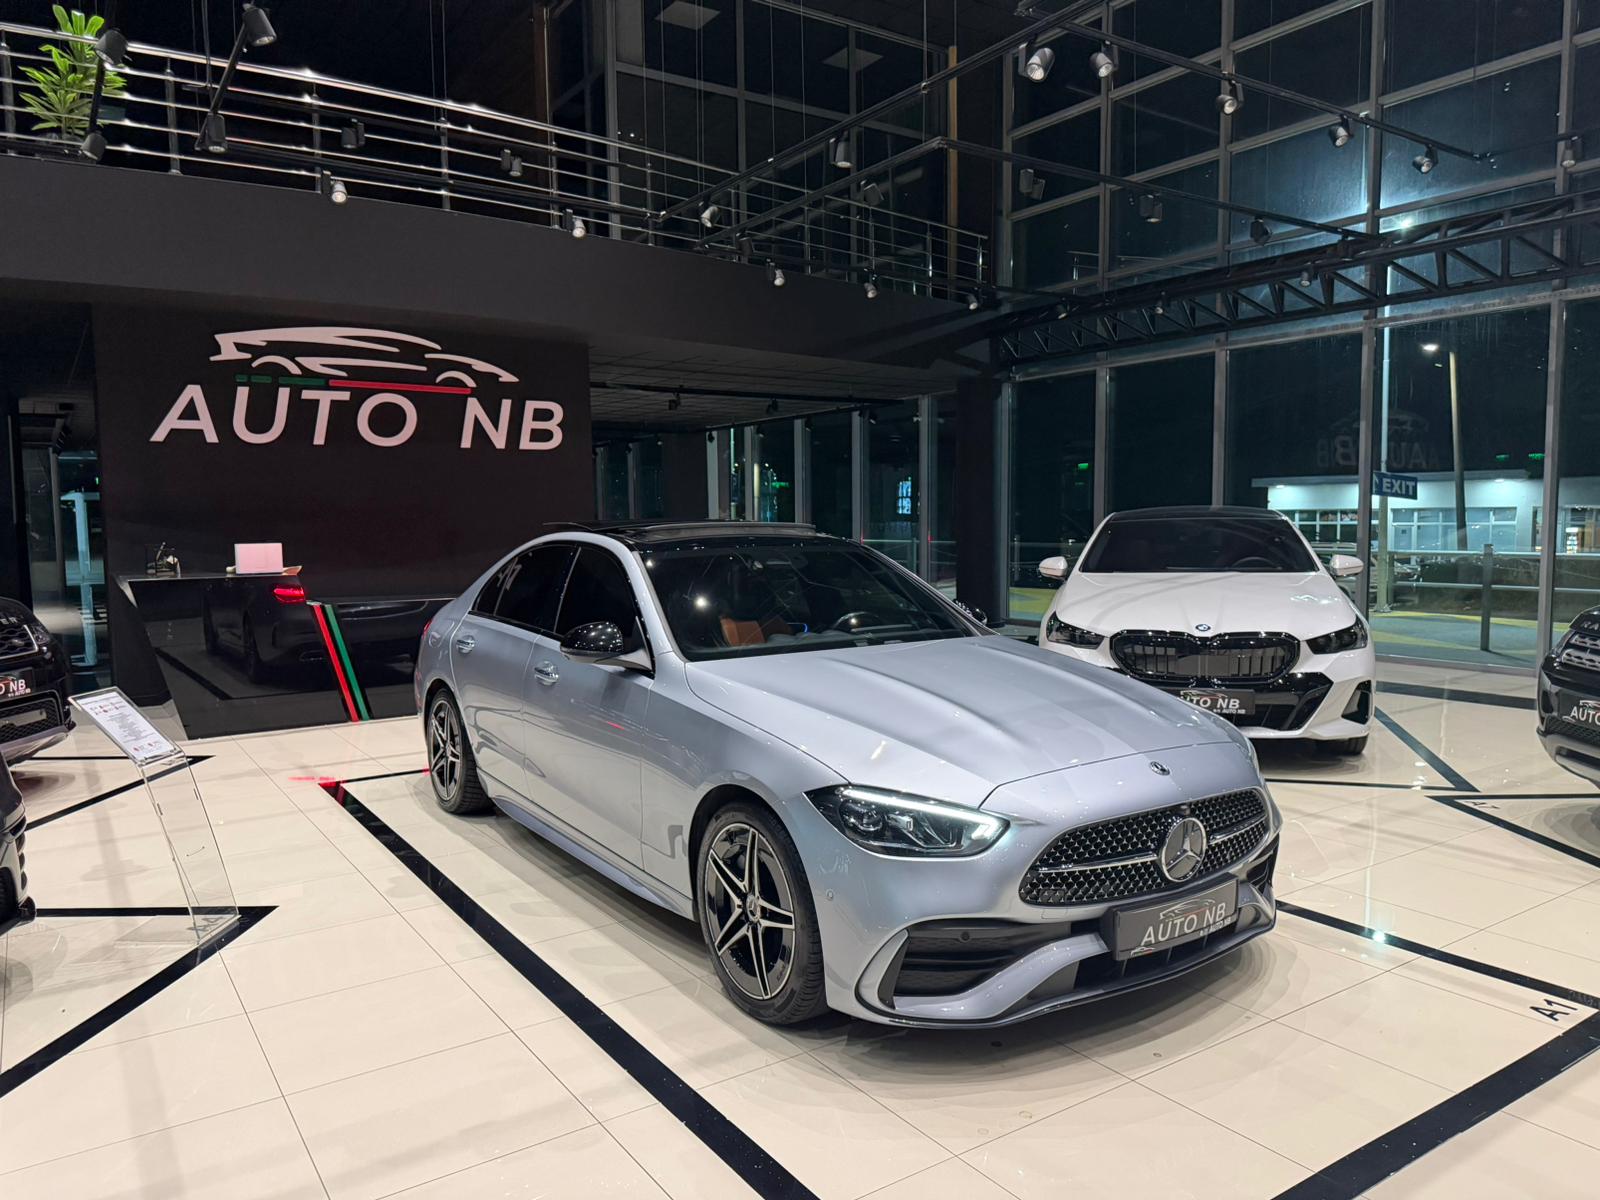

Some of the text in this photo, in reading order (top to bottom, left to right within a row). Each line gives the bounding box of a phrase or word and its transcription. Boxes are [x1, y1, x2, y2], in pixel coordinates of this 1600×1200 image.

[149, 384, 564, 450] AUTO NB
[1382, 478, 1415, 495] EXIT
[9, 679, 26, 692] NB
[1217, 698, 1240, 709] NB
[1141, 902, 1226, 946] AUTO NB
[1529, 999, 1578, 1022] A1
